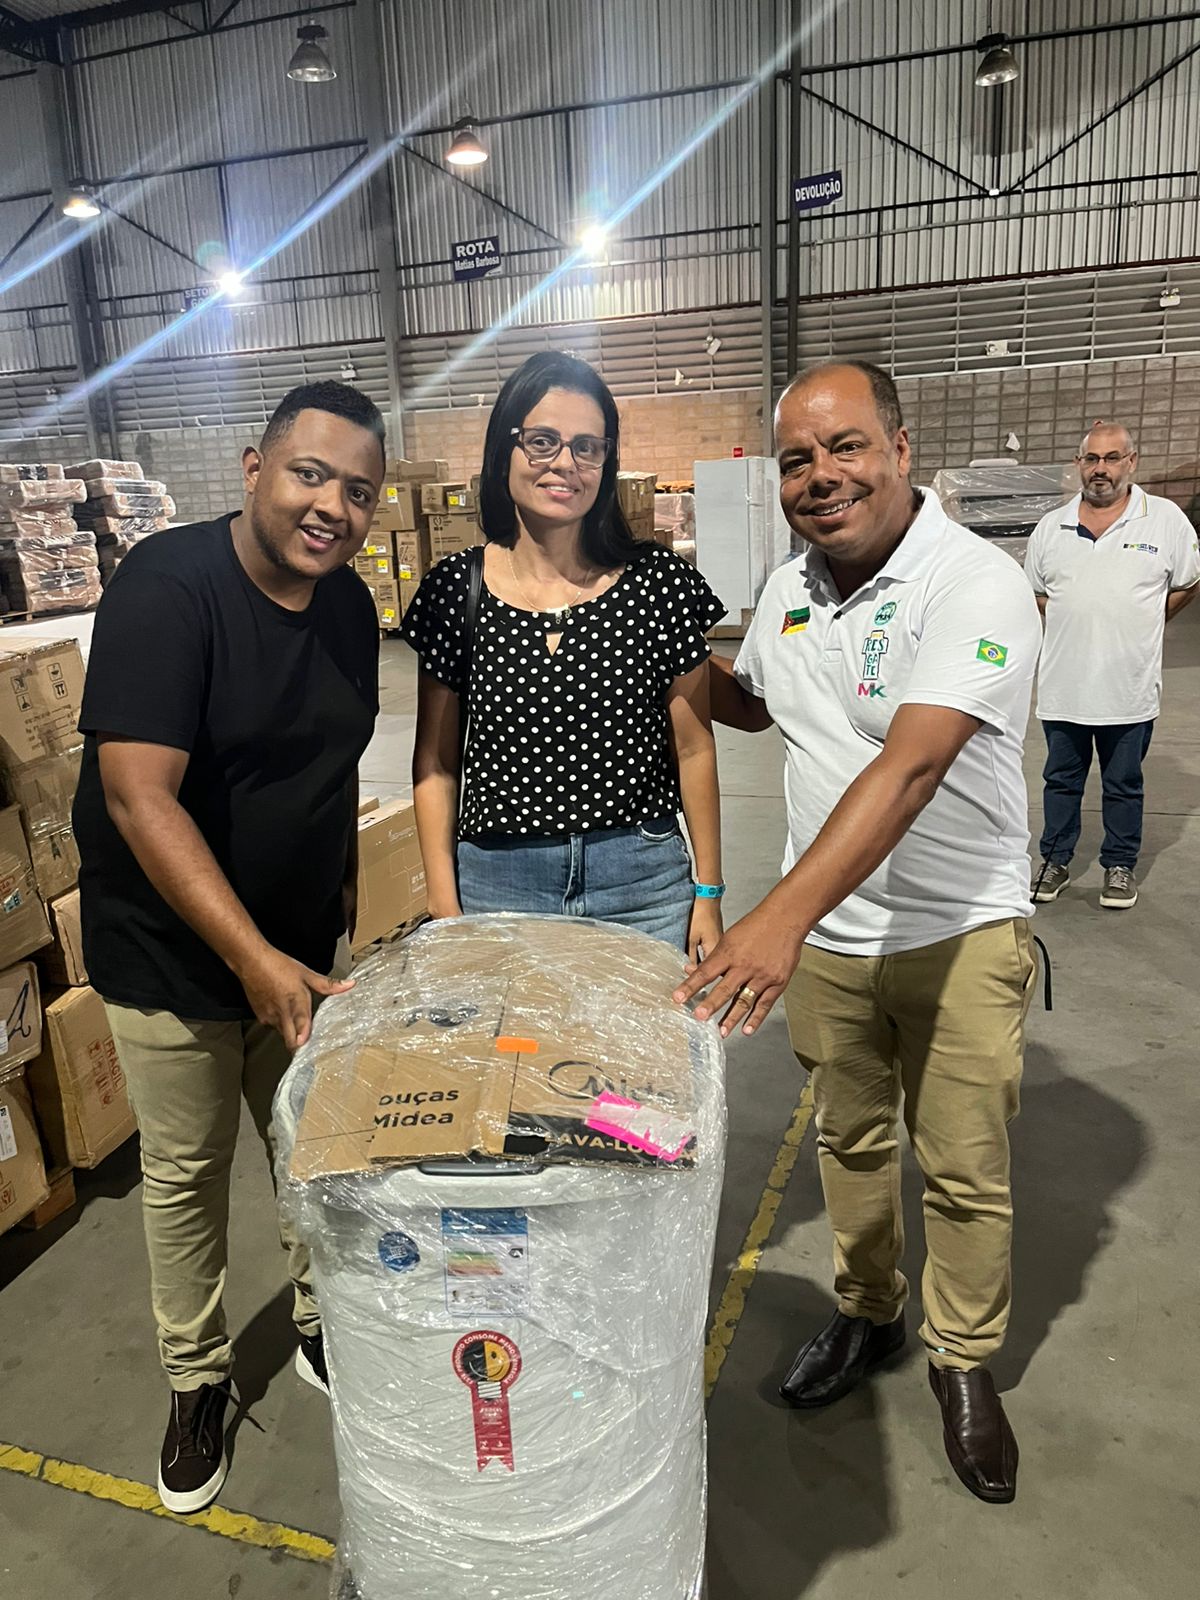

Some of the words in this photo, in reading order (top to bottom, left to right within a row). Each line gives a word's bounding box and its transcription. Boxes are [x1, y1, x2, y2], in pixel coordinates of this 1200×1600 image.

[795, 178, 841, 202] DEVOLUÇÃO
[456, 240, 495, 257] ROTA
[374, 1111, 454, 1128] Midea
[463, 1333, 499, 1345] CONSOME
